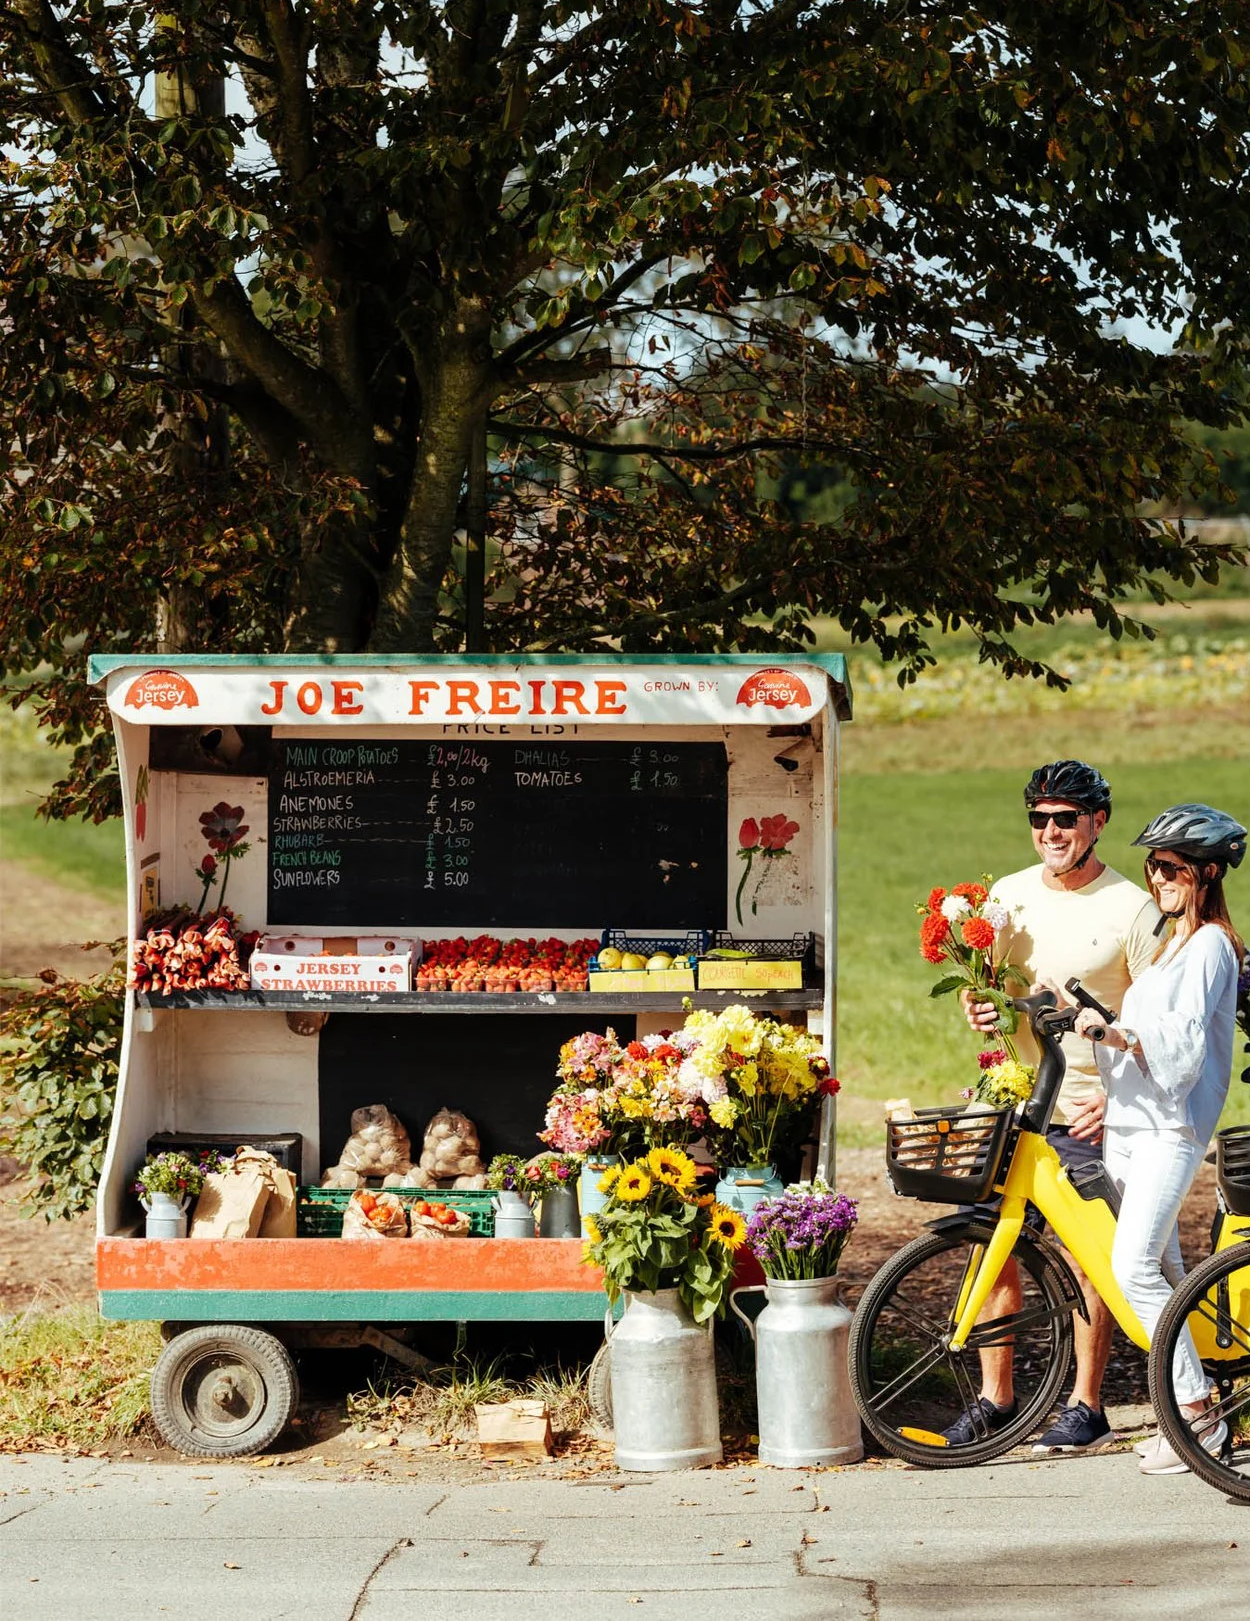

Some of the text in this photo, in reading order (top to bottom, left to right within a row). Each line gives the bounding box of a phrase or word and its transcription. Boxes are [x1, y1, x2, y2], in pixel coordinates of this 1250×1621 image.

[643, 681, 719, 692] GROWN BY:
[136, 689, 186, 705] Jersey
[261, 679, 627, 716] JOE FREIRE
[748, 688, 798, 704] Jersey
[286, 747, 317, 765] MAIN
[514, 750, 570, 767] DHALIAS
[514, 771, 583, 787] TOMATOES
[279, 794, 353, 812] ANEMONES
[275, 834, 324, 849] RHUBARB
[272, 851, 306, 866] FRENCH
[311, 850, 341, 866] BEANS
[273, 868, 340, 889] SUNFLOWERS
[296, 963, 362, 975] JERSEY
[261, 979, 397, 991] STRAWBERRIES
